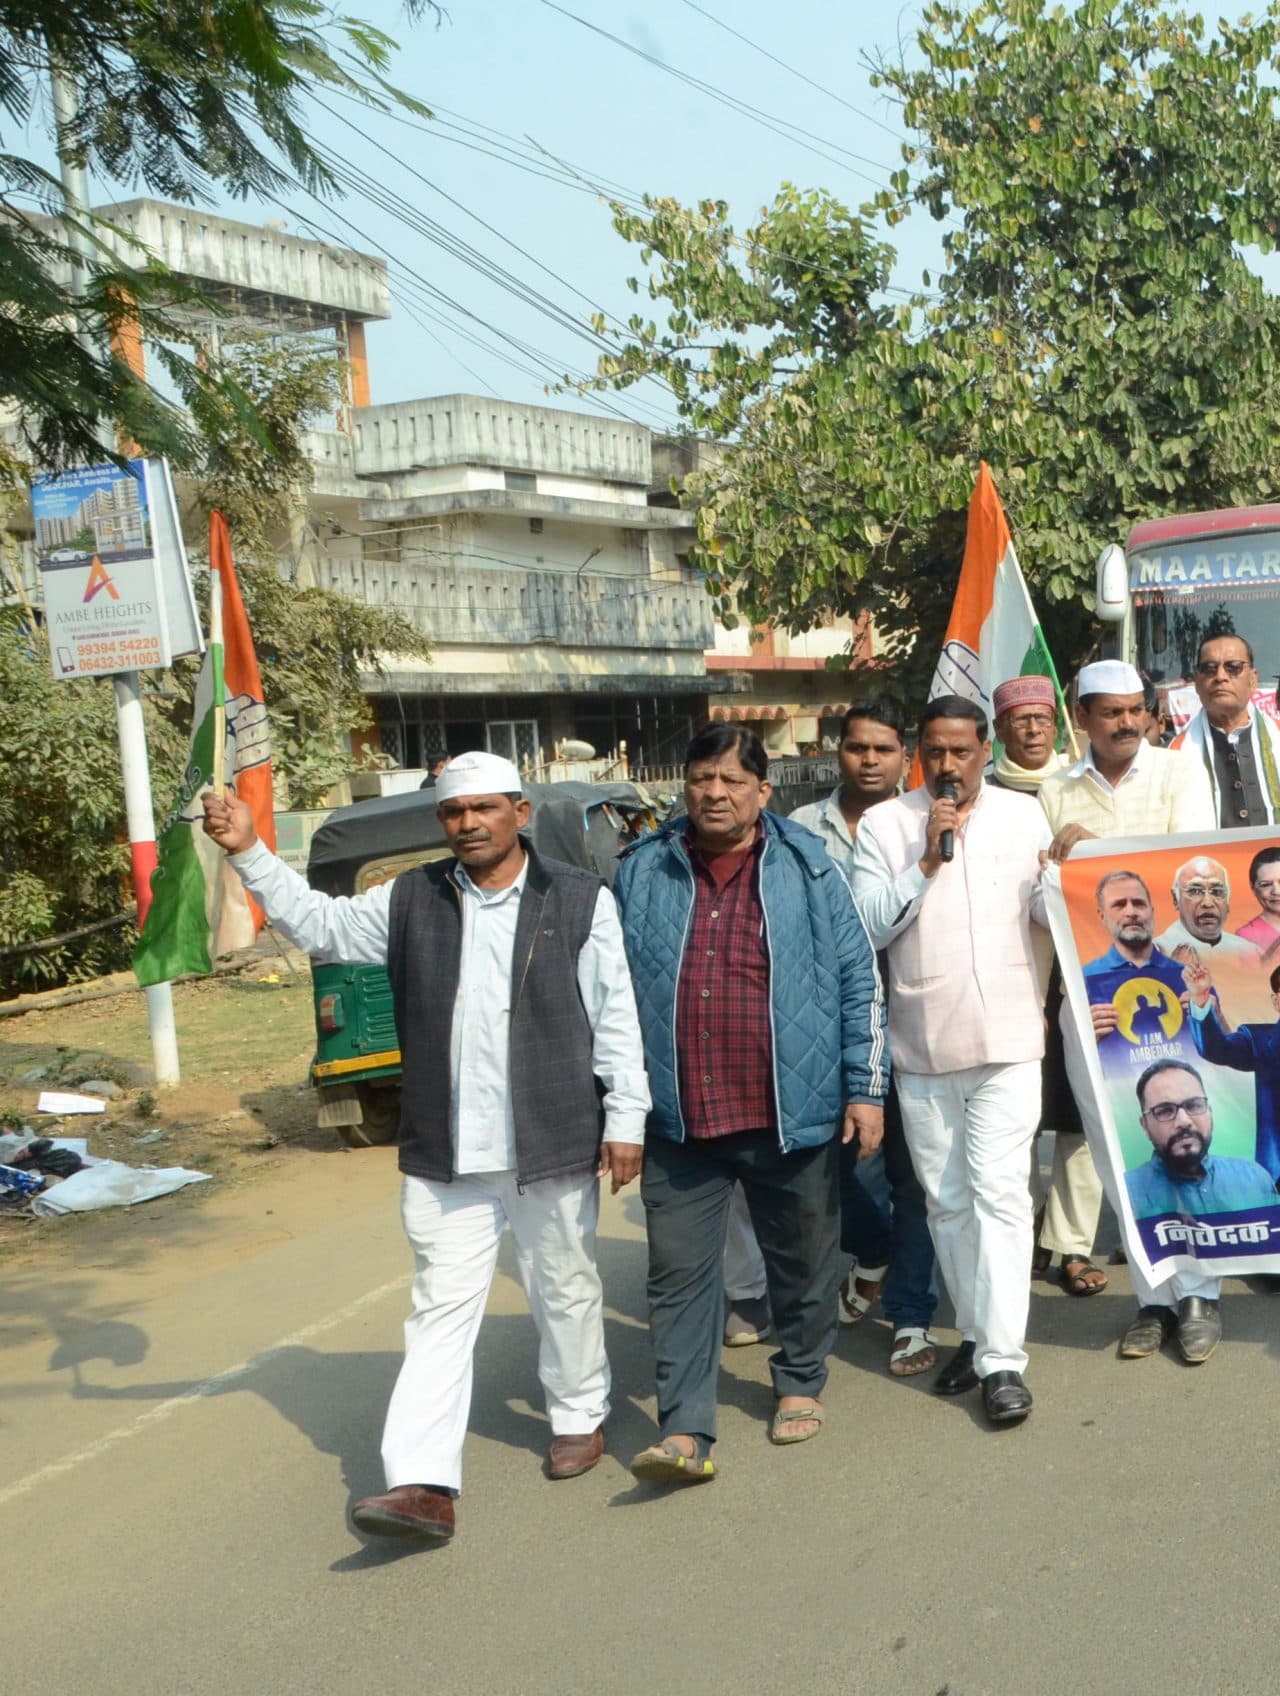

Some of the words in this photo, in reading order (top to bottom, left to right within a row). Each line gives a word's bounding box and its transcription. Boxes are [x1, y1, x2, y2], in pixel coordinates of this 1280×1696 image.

[56, 608, 88, 624] AMBE
[94, 601, 153, 619] HEIGHTS
[77, 642, 116, 657] 99394
[119, 637, 159, 652] 54220
[79, 651, 161, 673] 06432-311003
[1149, 1031, 1163, 1045] AM
[1129, 1043, 1183, 1062] AMBEDKAR
